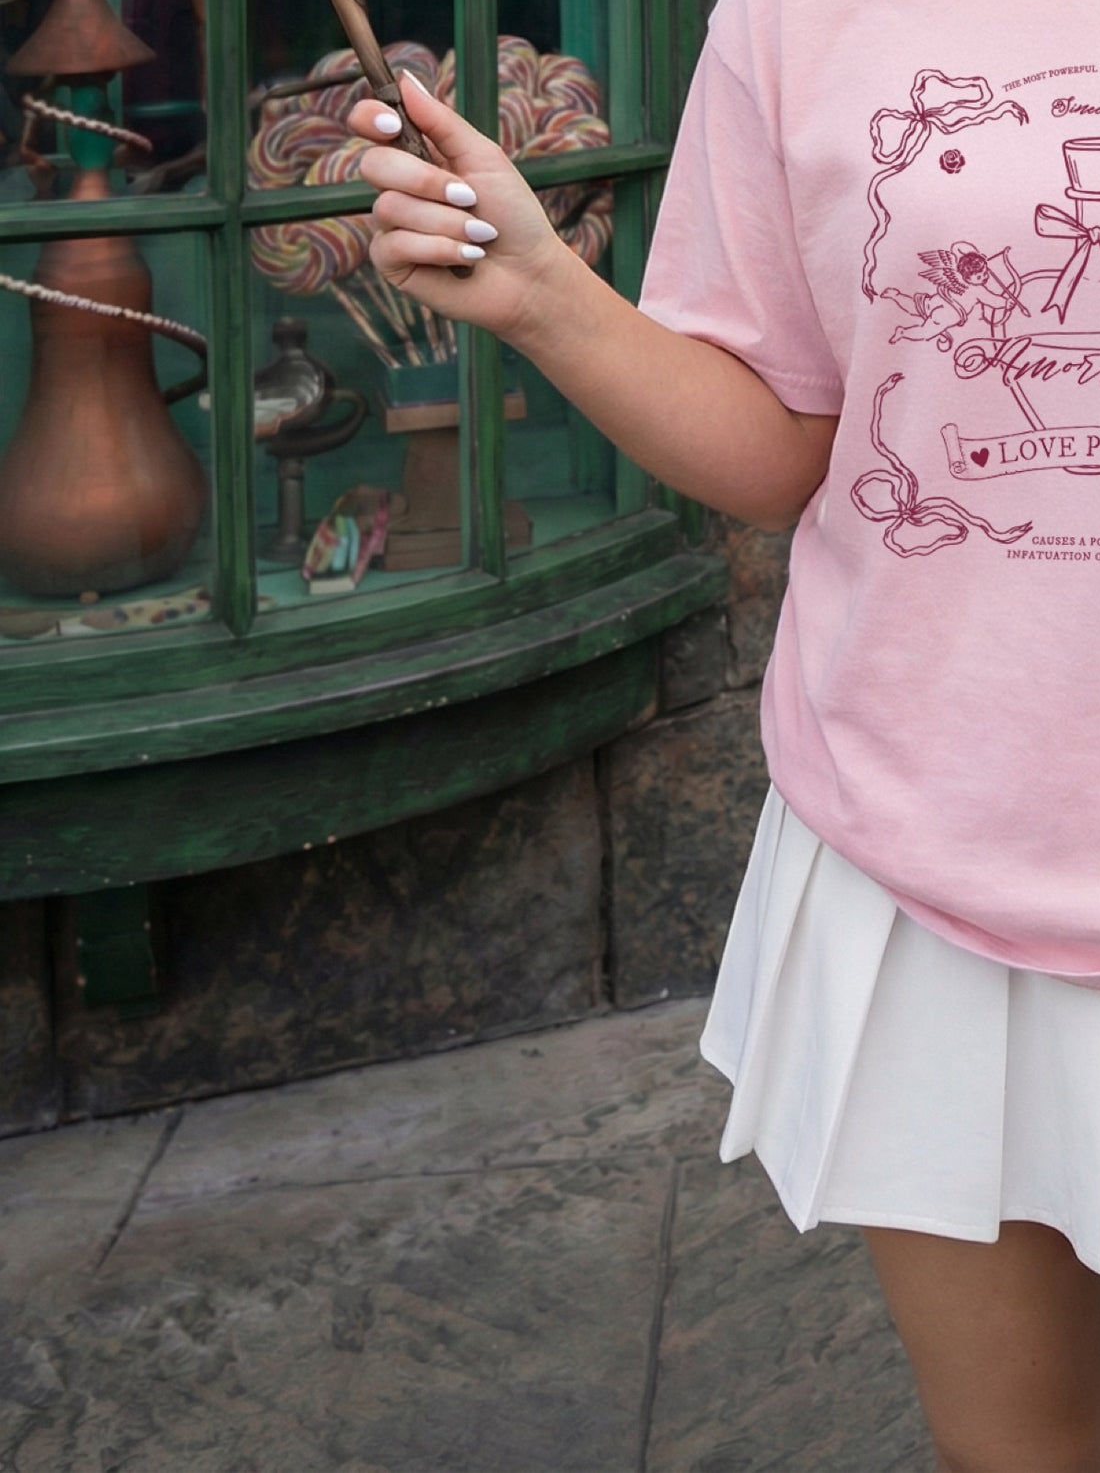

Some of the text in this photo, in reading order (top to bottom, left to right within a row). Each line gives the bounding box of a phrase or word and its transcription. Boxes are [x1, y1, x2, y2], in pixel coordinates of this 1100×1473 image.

[1002, 79, 1022, 93] THE
[1022, 71, 1047, 86] MOST
[1049, 64, 1098, 78] POWERFUL
[998, 436, 1077, 464] LOVE
[1031, 536, 1076, 547] CAUSES
[1078, 537, 1086, 547] A
[1007, 549, 1091, 561] INFATUATION
